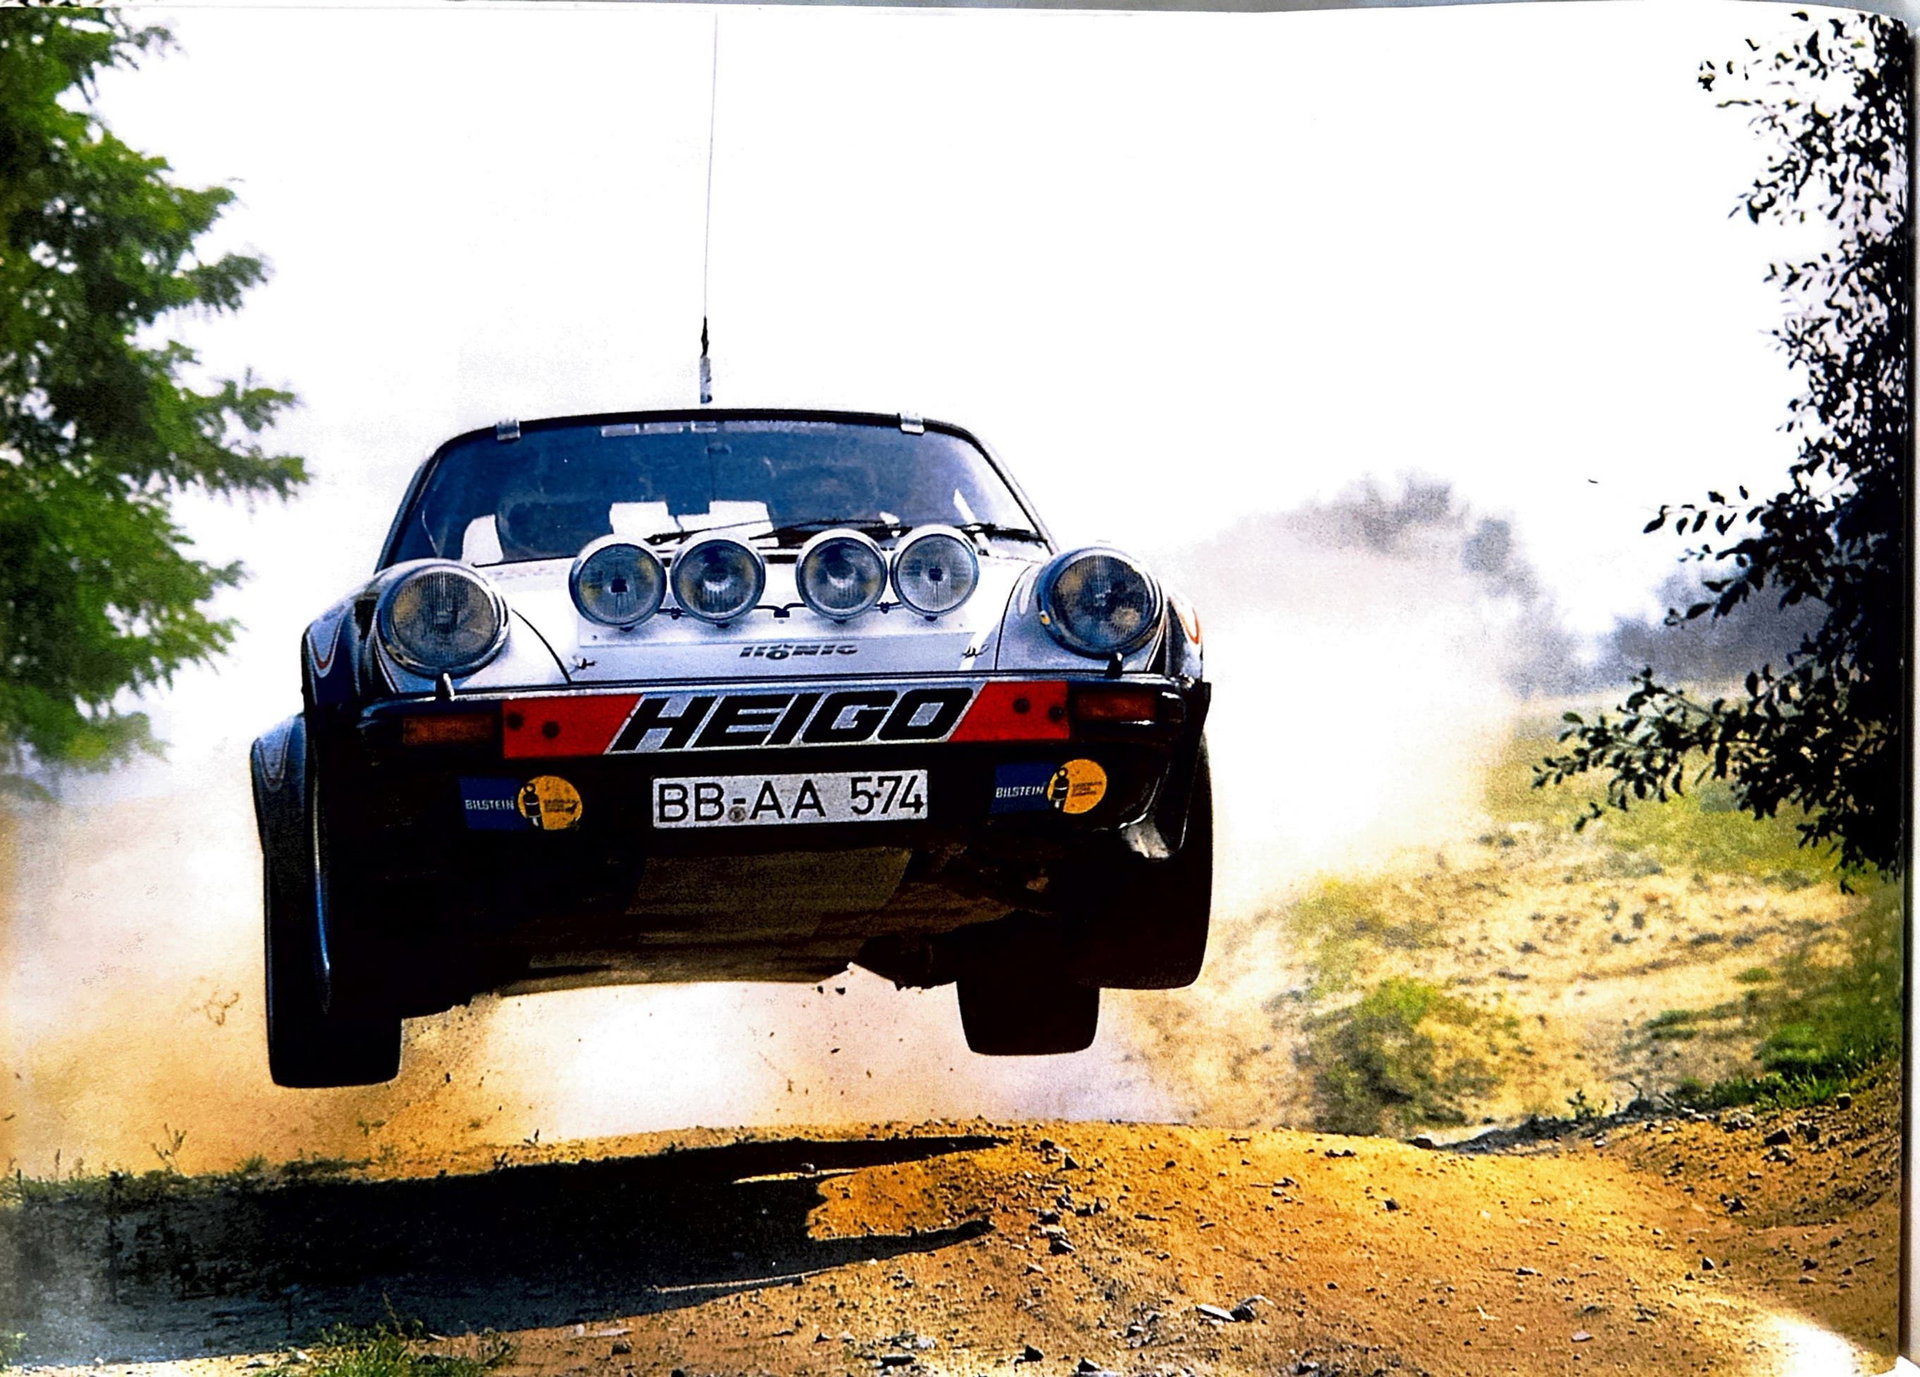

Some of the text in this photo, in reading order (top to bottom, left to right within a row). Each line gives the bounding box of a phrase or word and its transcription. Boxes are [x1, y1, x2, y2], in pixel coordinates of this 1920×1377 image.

[611, 688, 974, 751] HEIGO
[464, 798, 515, 811] BILSTEIN
[850, 775, 925, 815] 574
[995, 785, 1045, 799] BILSTEIN
